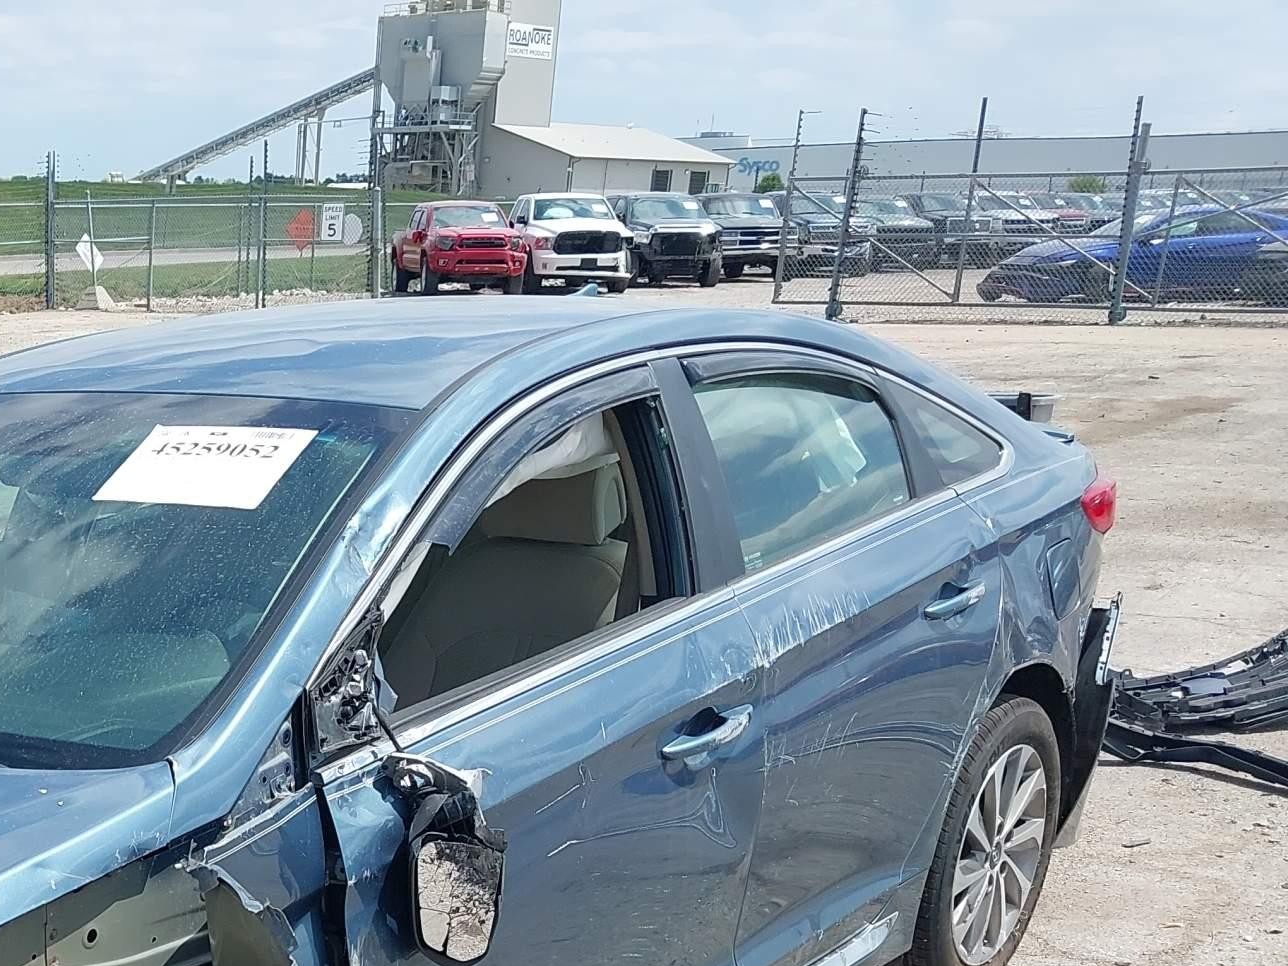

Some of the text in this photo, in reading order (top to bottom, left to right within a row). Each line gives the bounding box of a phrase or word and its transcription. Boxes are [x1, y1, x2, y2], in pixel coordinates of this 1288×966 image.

[509, 28, 552, 46] ROANOKE
[327, 223, 337, 237] 5
[152, 442, 280, 458] 45259052
